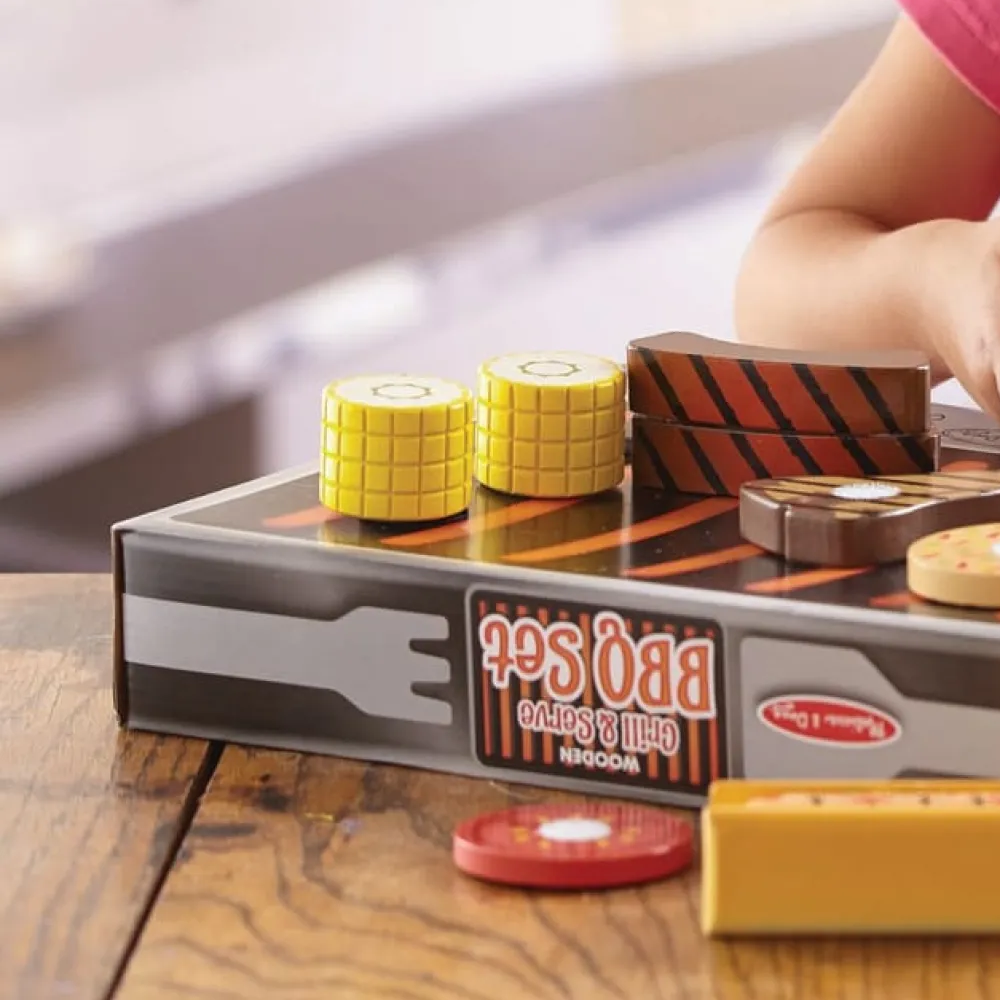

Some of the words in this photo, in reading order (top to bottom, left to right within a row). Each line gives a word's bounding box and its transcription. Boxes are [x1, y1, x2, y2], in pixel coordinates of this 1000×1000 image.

[480, 614, 586, 701] Set
[594, 611, 716, 719] BBQ
[518, 700, 595, 744] Serve
[597, 711, 618, 745] &
[622, 713, 680, 755] Grill
[560, 746, 640, 772] WOODEN
